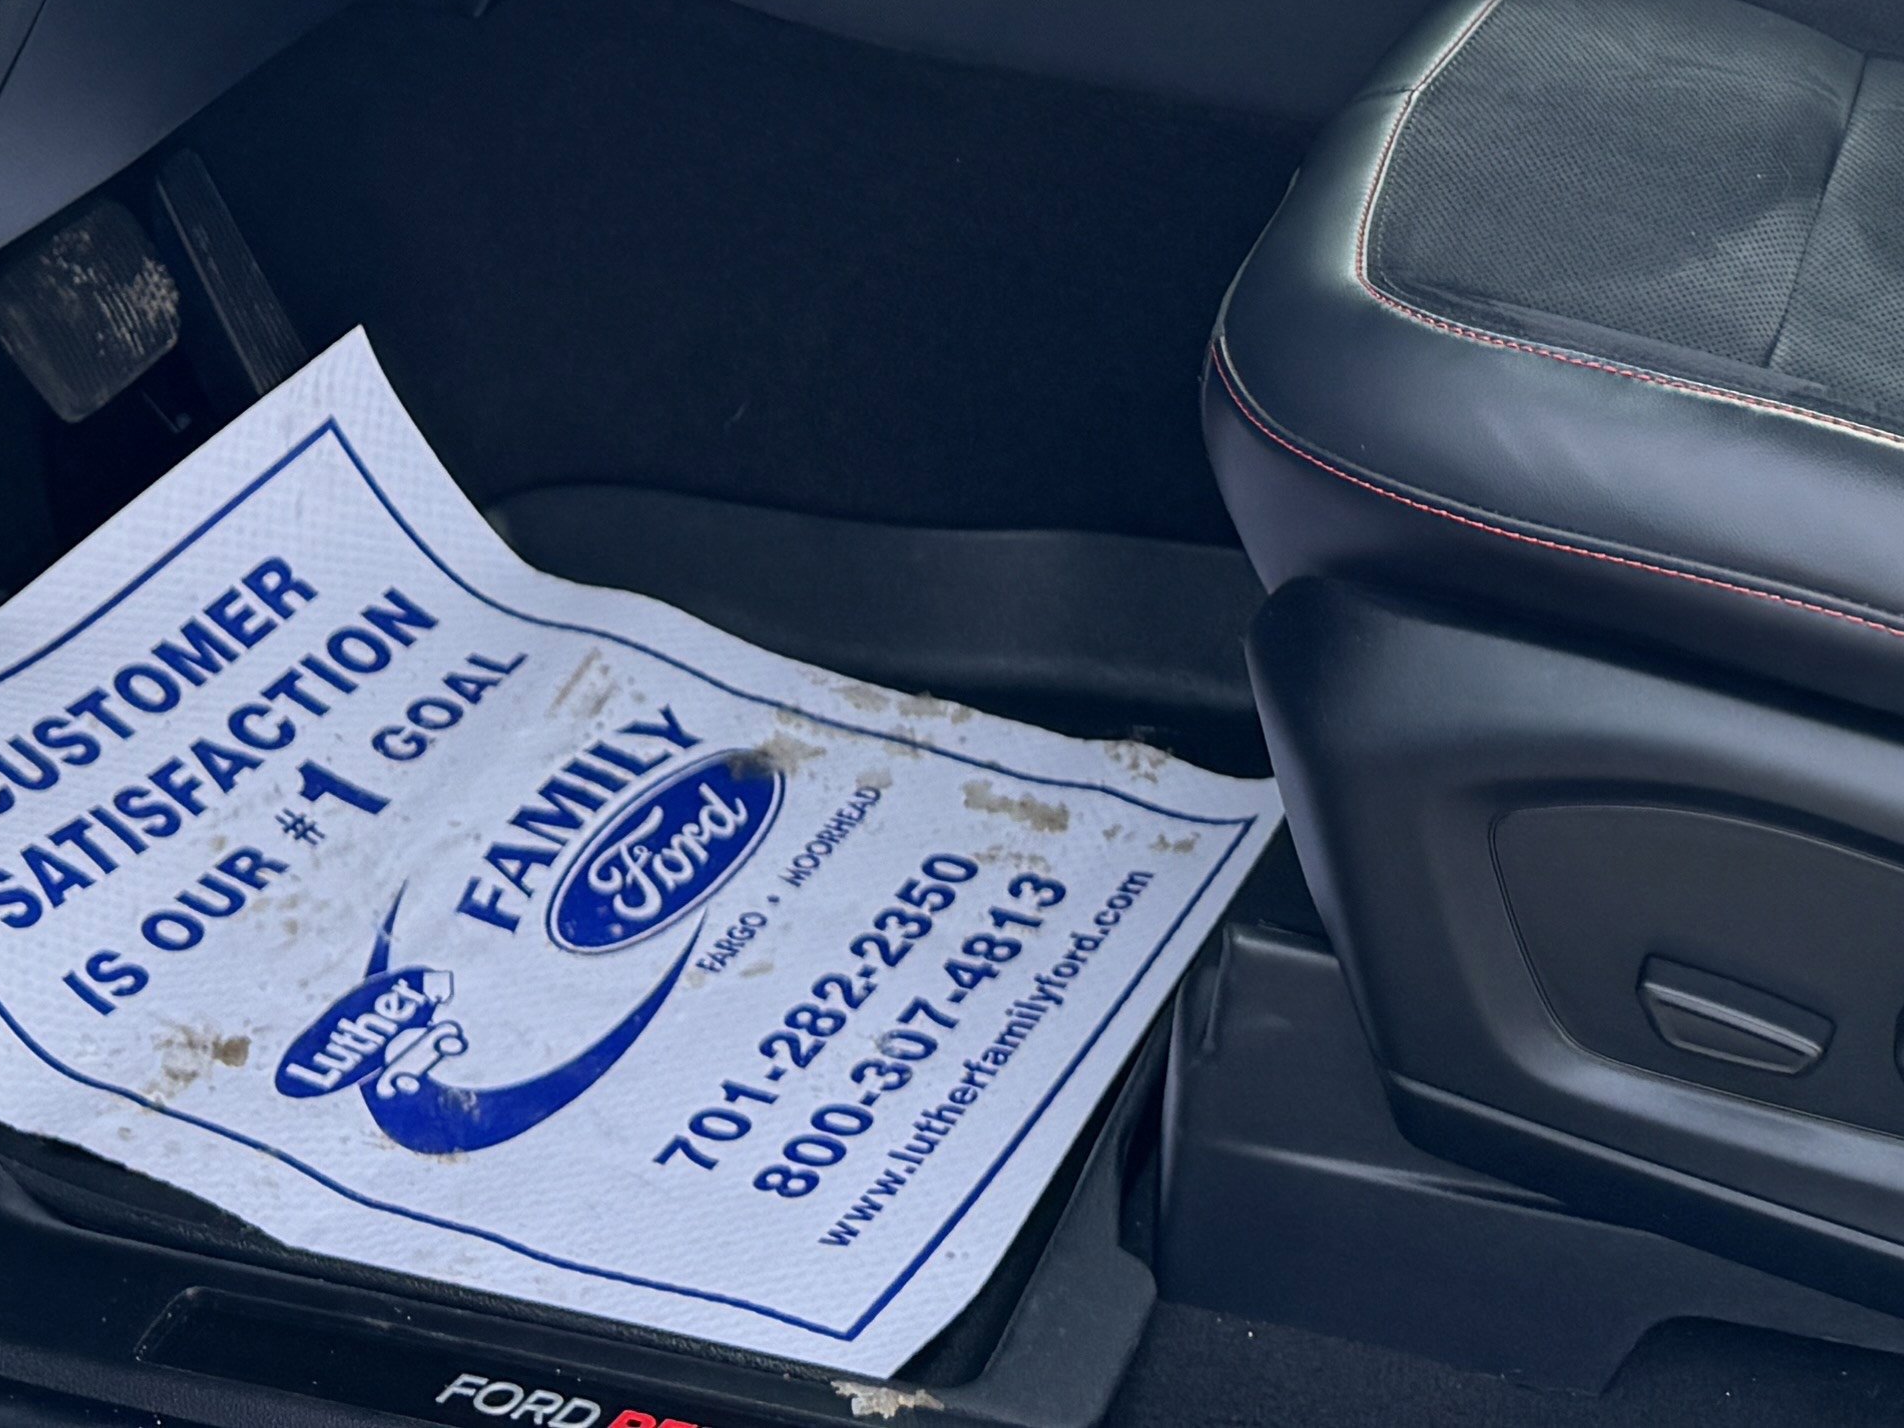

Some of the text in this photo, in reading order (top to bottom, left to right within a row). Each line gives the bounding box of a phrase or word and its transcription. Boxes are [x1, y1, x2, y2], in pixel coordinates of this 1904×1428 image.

[62, 651, 529, 1016] IS OUR #1 GOAL
[456, 703, 704, 934] FAMILY
[588, 782, 749, 921] Ford
[696, 785, 882, 974] FARGO MOORHEAD
[285, 978, 427, 1089] Luther
[652, 852, 979, 1170] 701-282-2350
[752, 871, 1067, 1199] 800-307-4813
[818, 869, 1154, 1247] www.lutherfamilyford.com
[436, 1373, 601, 1428] FORD
